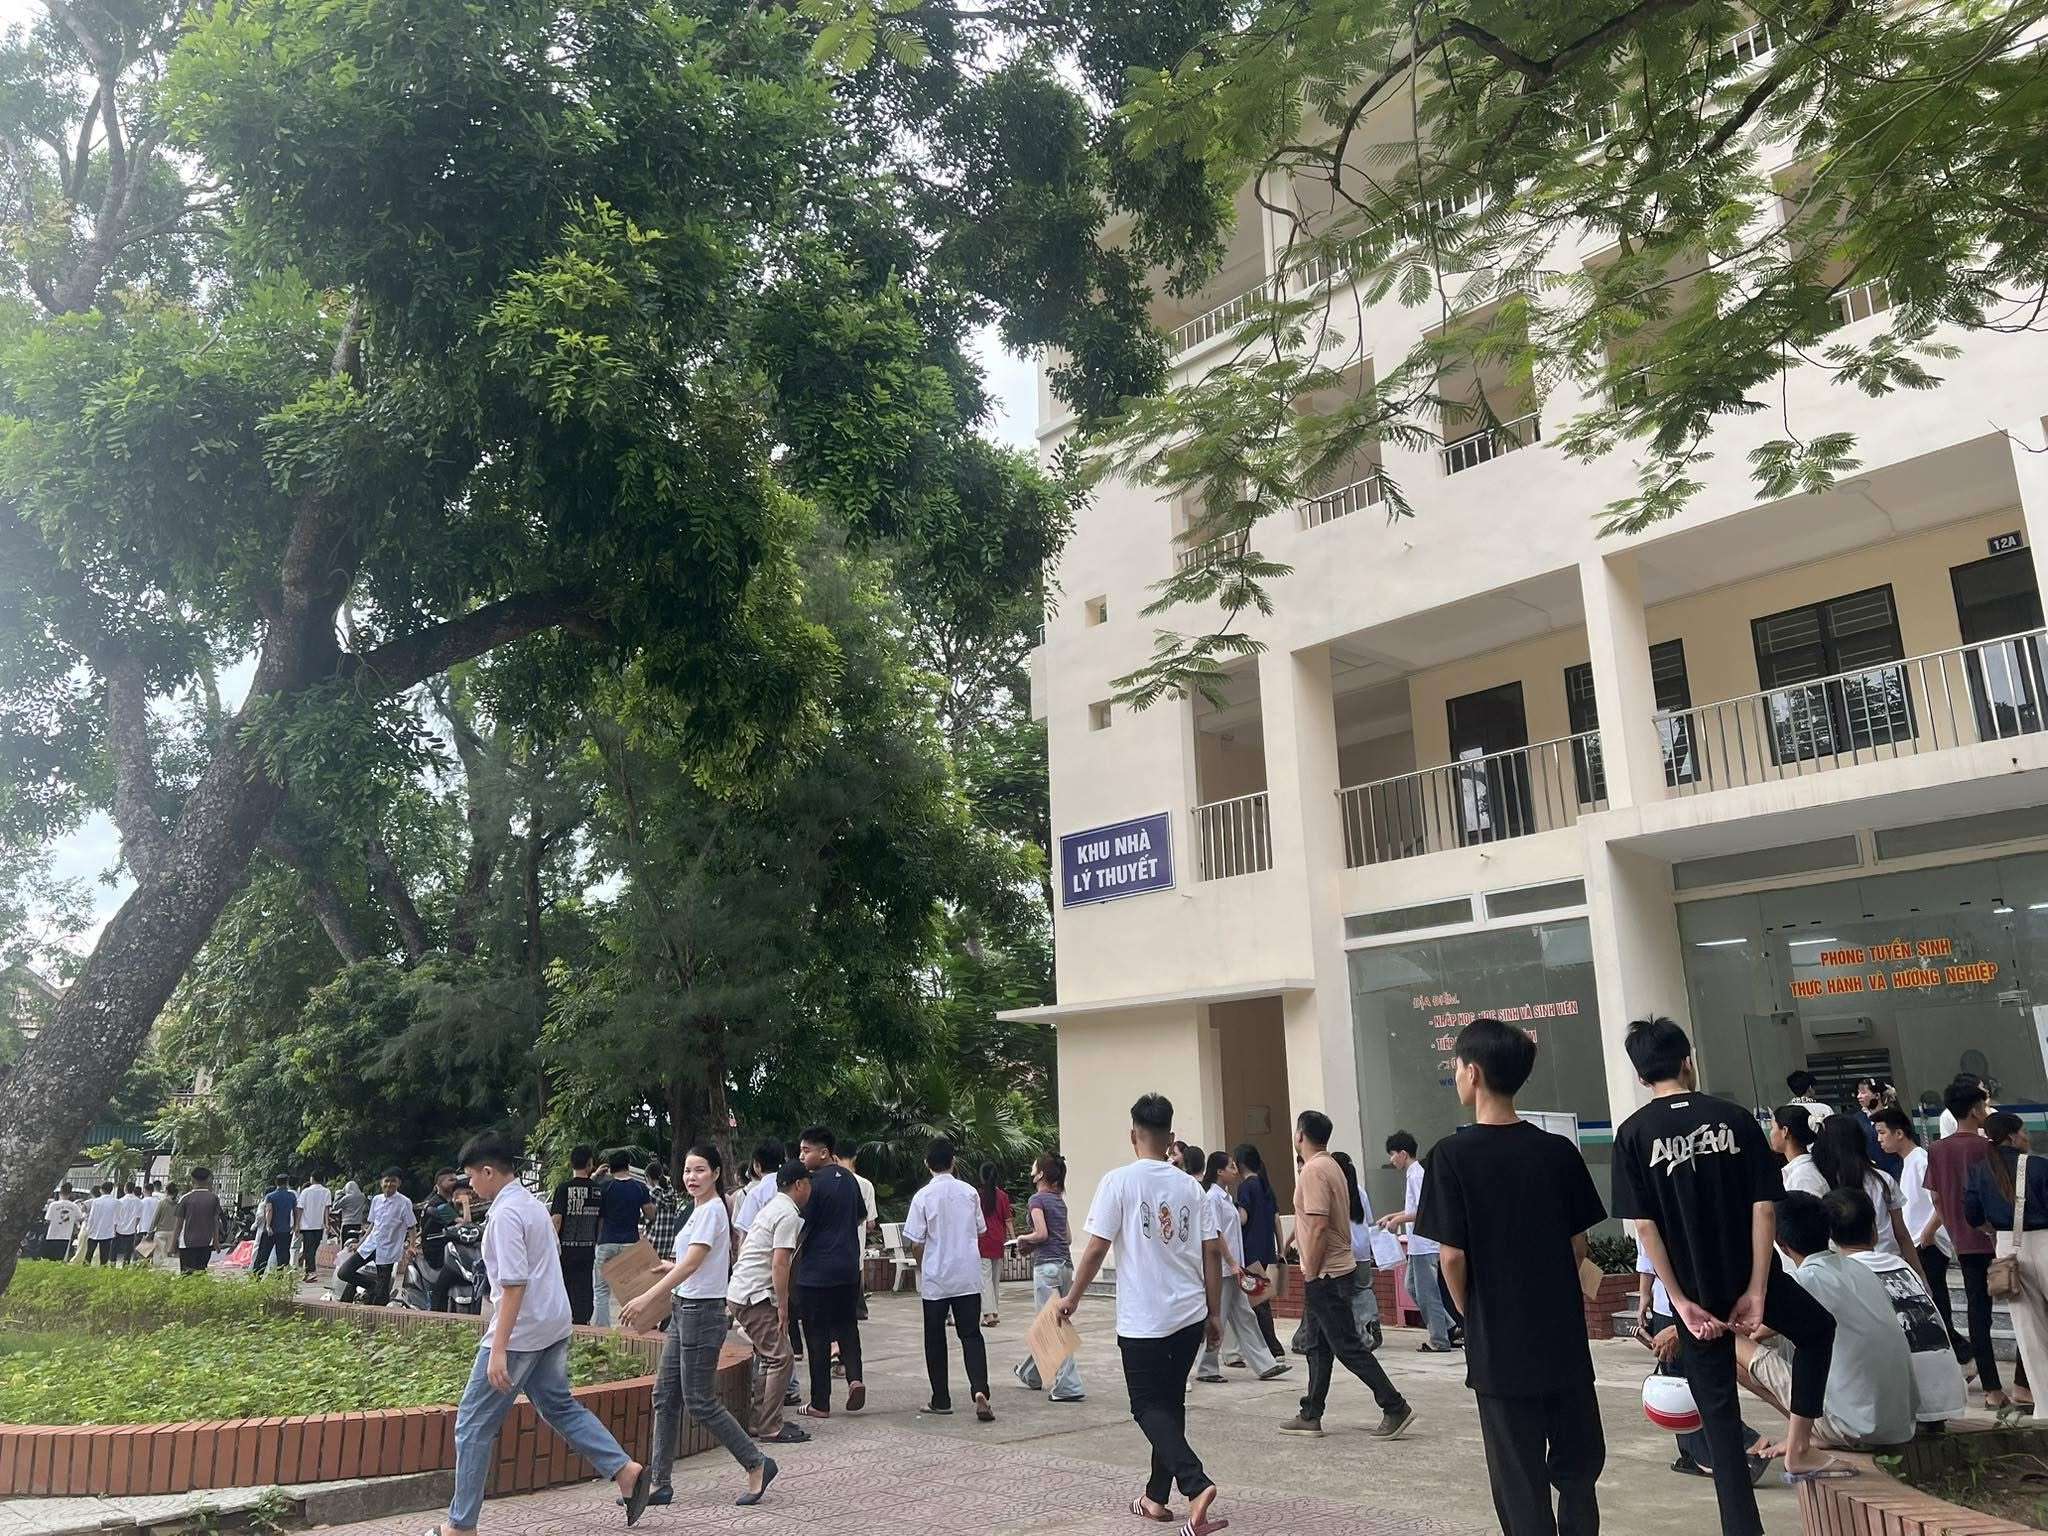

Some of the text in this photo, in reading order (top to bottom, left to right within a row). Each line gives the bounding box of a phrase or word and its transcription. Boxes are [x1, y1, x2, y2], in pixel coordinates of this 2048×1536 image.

[1993, 535, 2017, 550] 12A
[1077, 828, 1151, 865] KHU NHÀ
[1073, 853, 1158, 893] LÝ THUYẾT
[1820, 937, 1952, 968] PHÒNG TUYỂN SINH
[1790, 959, 1999, 999] THỰC HÀNH VÀ HƯỚNG NGHIỆP
[1498, 1007, 1520, 1022] SINH
[1520, 1003, 1533, 1020] VÀ
[1533, 1003, 1556, 1019] SINH
[567, 1186, 589, 1199] NEVER
